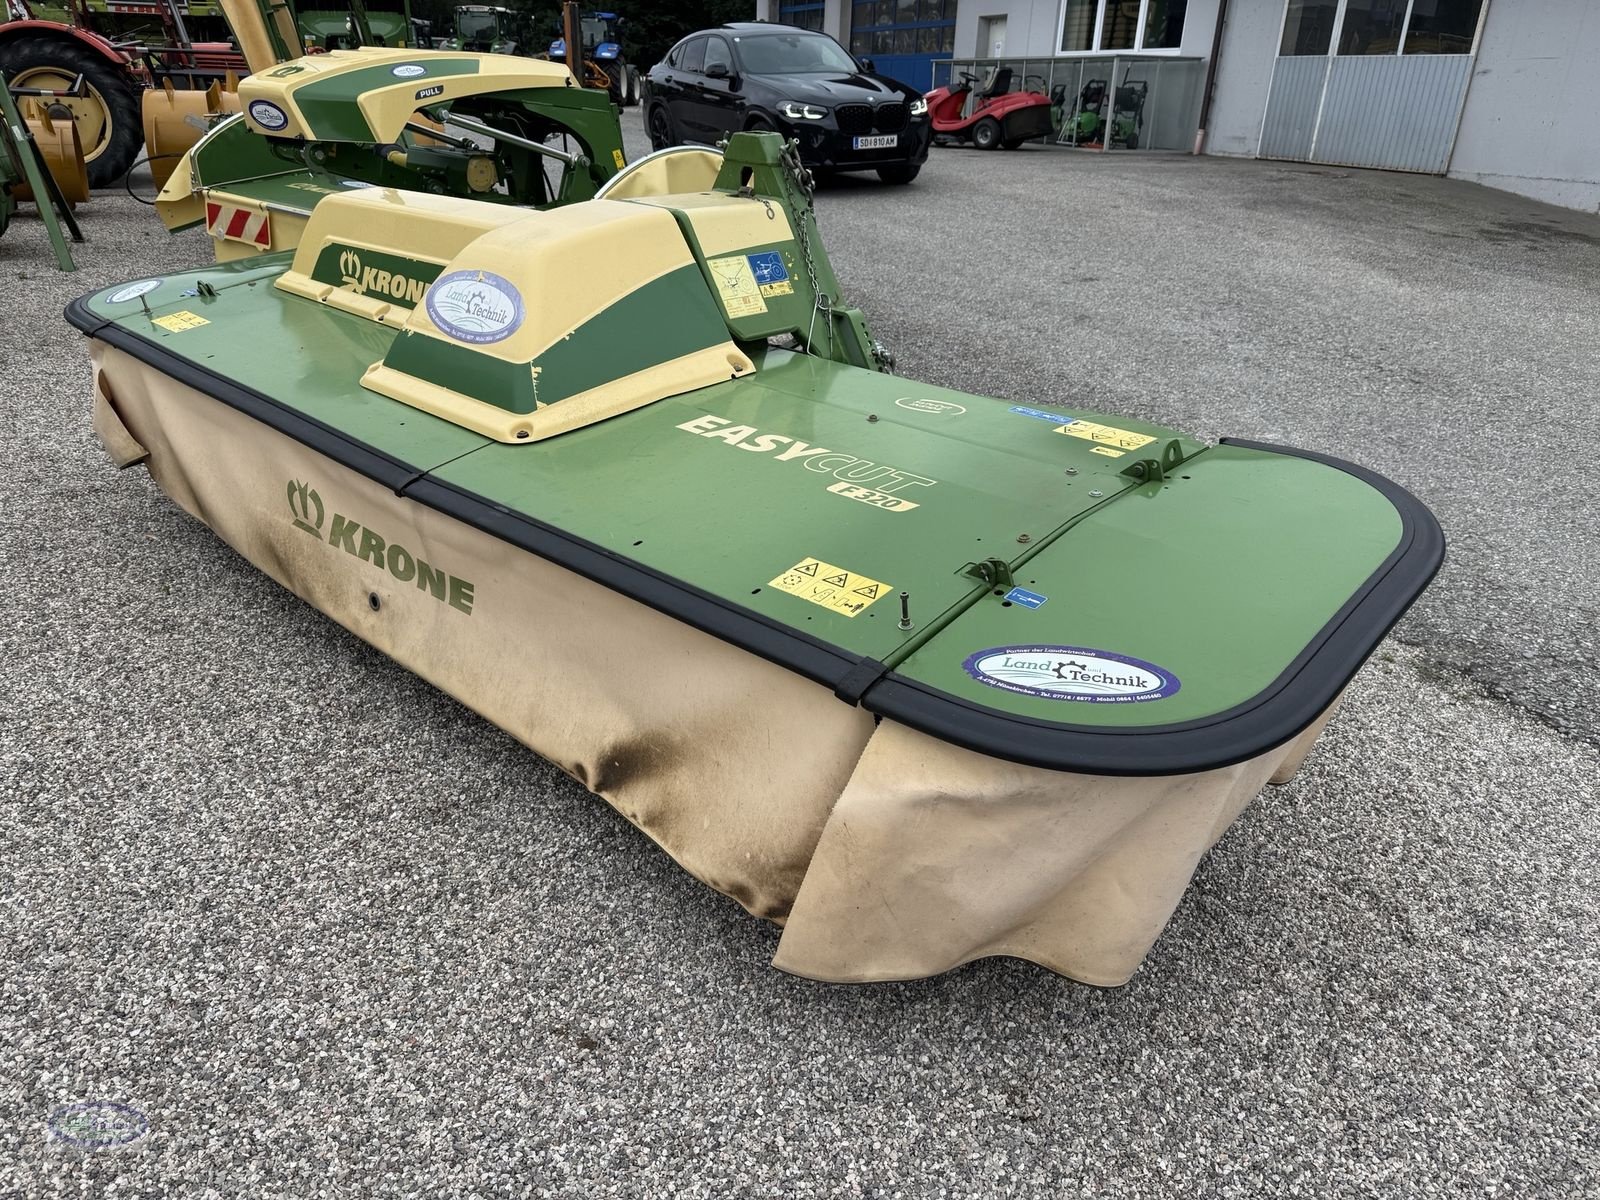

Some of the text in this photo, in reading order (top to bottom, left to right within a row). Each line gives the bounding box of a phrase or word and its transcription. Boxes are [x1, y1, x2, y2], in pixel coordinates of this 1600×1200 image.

[420, 87, 441, 98] PULL
[860, 138, 869, 147] SD
[445, 285, 470, 304] Land
[472, 303, 508, 325] Technik
[675, 414, 938, 494] EASYCUT
[836, 486, 903, 508] F 320
[328, 513, 475, 617] KRONE
[1002, 657, 1052, 671] Land
[1069, 670, 1148, 688] Technik
